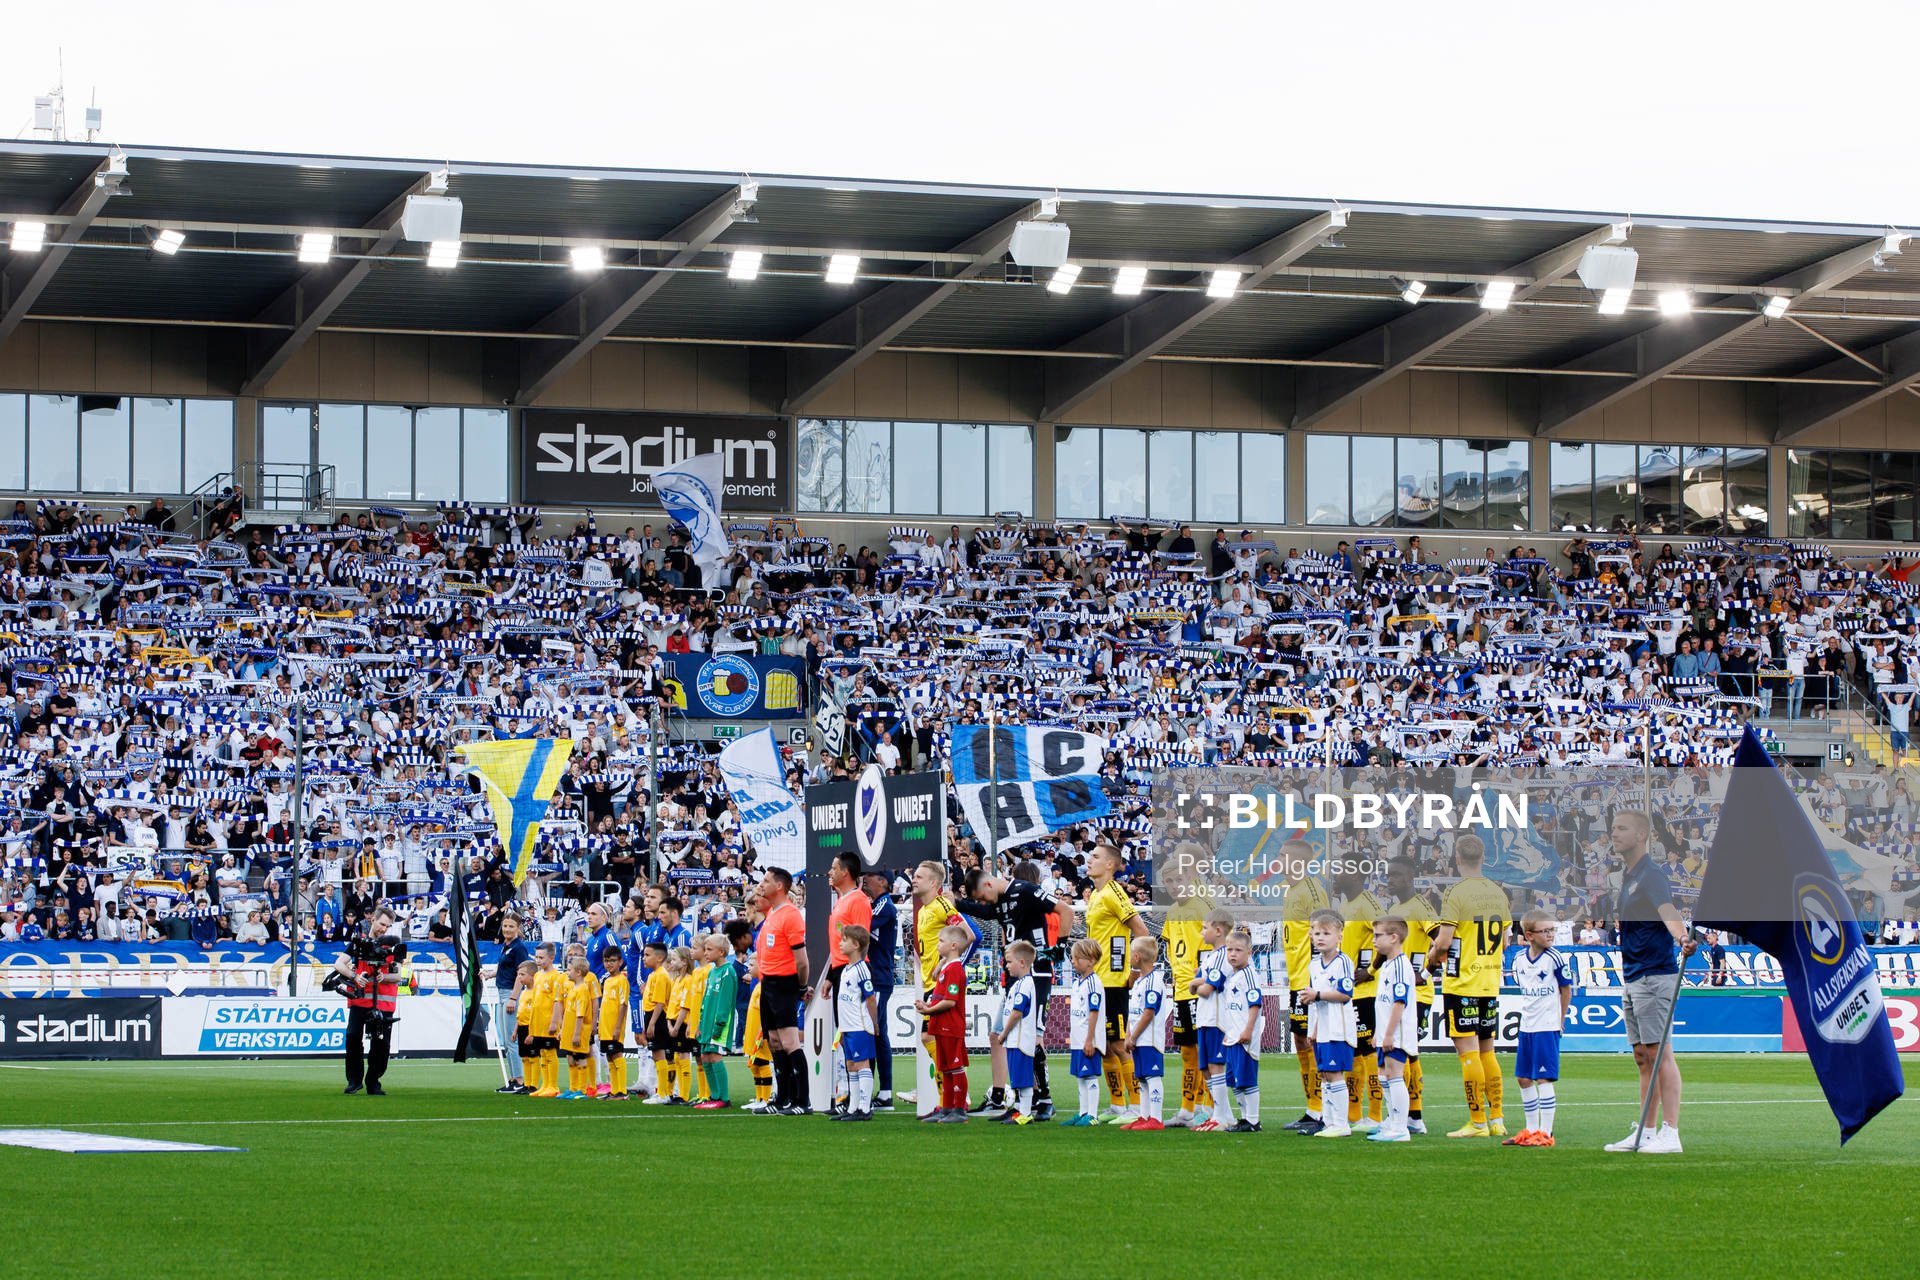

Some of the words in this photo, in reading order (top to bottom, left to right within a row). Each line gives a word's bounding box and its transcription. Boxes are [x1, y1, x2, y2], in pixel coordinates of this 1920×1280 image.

[630, 478, 652, 493] Joi
[791, 728, 805, 744] G
[1830, 744, 1843, 760] H
[811, 803, 848, 831] UNIBET
[893, 793, 933, 824] UNIBET
[1473, 915, 1503, 956] 19
[1813, 944, 1872, 1012] ALLSVENSKAN
[215, 1003, 346, 1024] STÅTHÖGA
[1836, 990, 1871, 1030] UNIBET
[16, 1014, 151, 1042] stadium
[215, 1031, 313, 1048] VERKSTAD
[317, 1031, 344, 1047] AB
